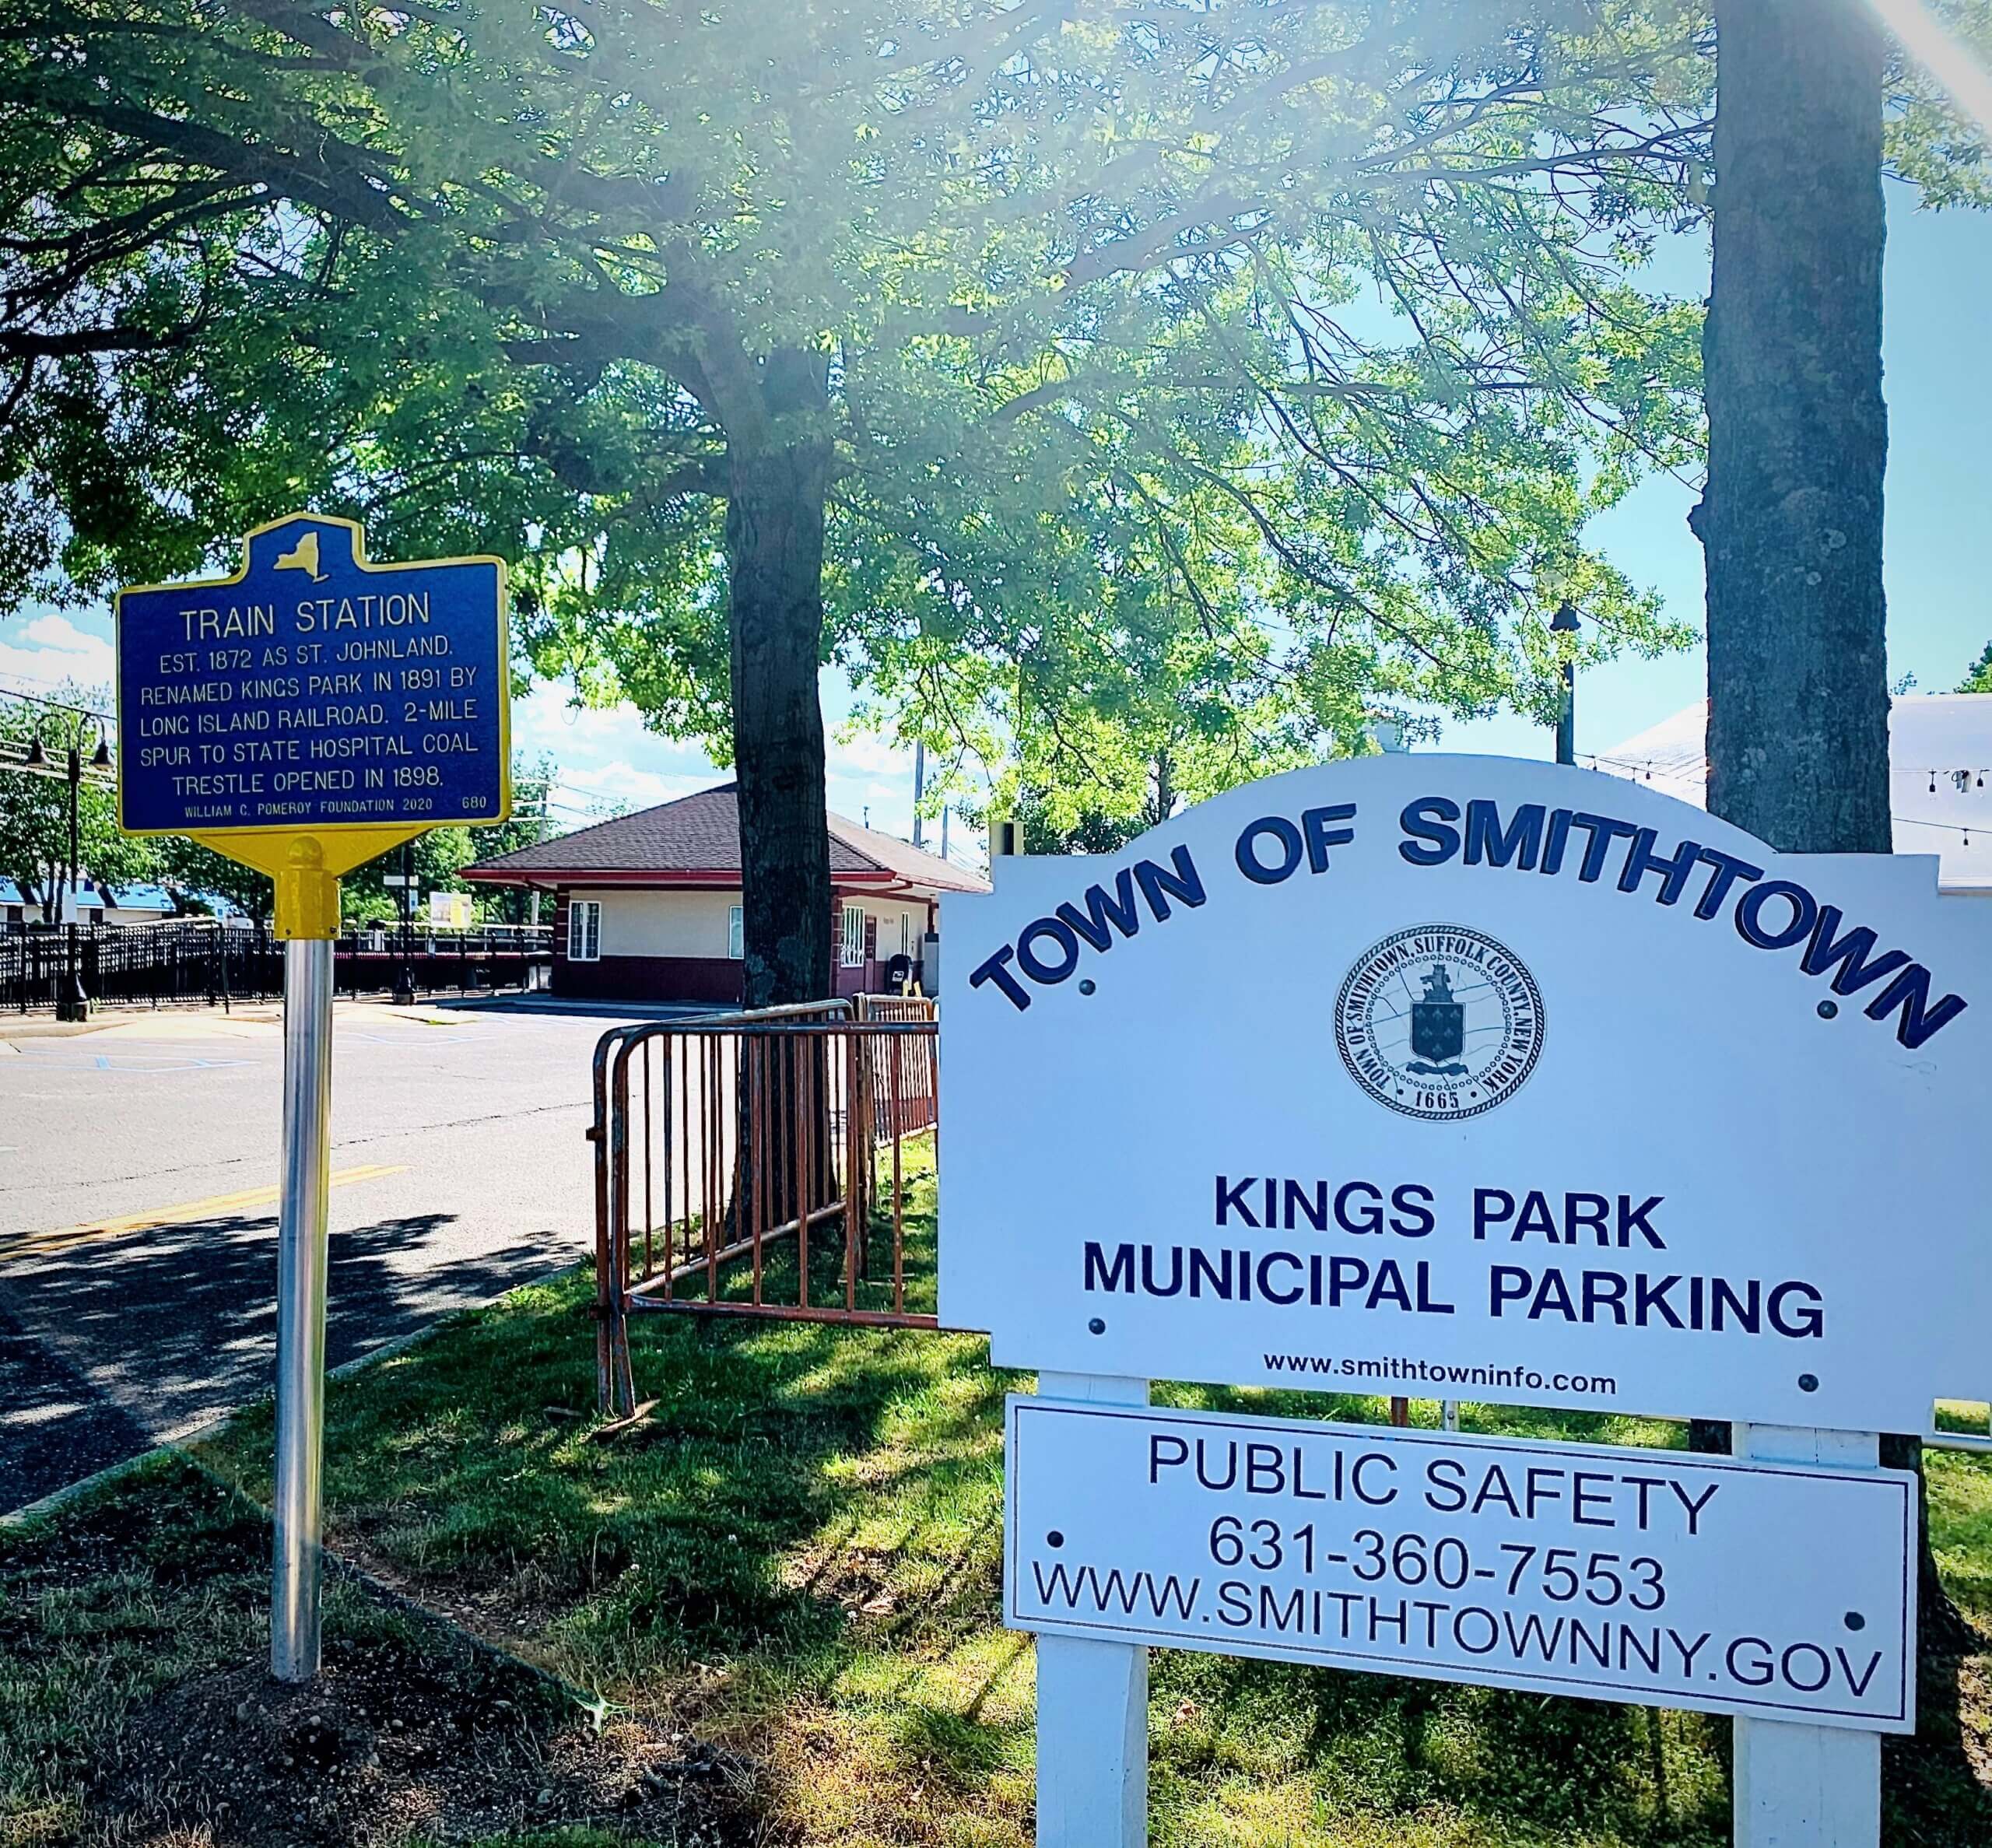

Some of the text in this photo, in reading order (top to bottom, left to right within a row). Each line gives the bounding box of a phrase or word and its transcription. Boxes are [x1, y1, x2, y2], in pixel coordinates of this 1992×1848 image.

[180, 592, 430, 640] TRAIN STATION
[160, 634, 454, 674] EST. 1872 AS ST. JOHNLAND.
[141, 667, 478, 705] RENAMED KINGS PARK IN 1891 BY
[141, 699, 478, 737] LONG ISLAND RAILROAD. 2-MILE
[141, 732, 479, 766] SPUR TO STATE HOSPITAL COAL
[173, 766, 444, 796] TRESTLE OPENED IN 1898.
[184, 798, 433, 818] WILLIAM C. POMEROY FOUNDATION 2020
[461, 796, 487, 810] 680
[970, 795, 1969, 1049] TOWN OF SMITHTOWN
[1415, 935, 1489, 963] SUFFOLK
[1346, 1026, 1365, 1044] OF
[1512, 1017, 1533, 1054] NEW
[1353, 1049, 1391, 1089] TOWN
[1482, 1055, 1522, 1094] YORK
[1415, 1091, 1460, 1109] 1665
[1215, 1175, 1667, 1250] KINGS PARK
[1083, 1242, 1825, 1338] MUNICIPAL PARKING
[1263, 1351, 1616, 1394] www.smithtowninfo.com
[1149, 1434, 1719, 1535] PUBLIC SAFETY
[1209, 1516, 1666, 1611] 631-360-7553
[1032, 1561, 1883, 1697] WWW.SMITHTOWNNY.GOV
